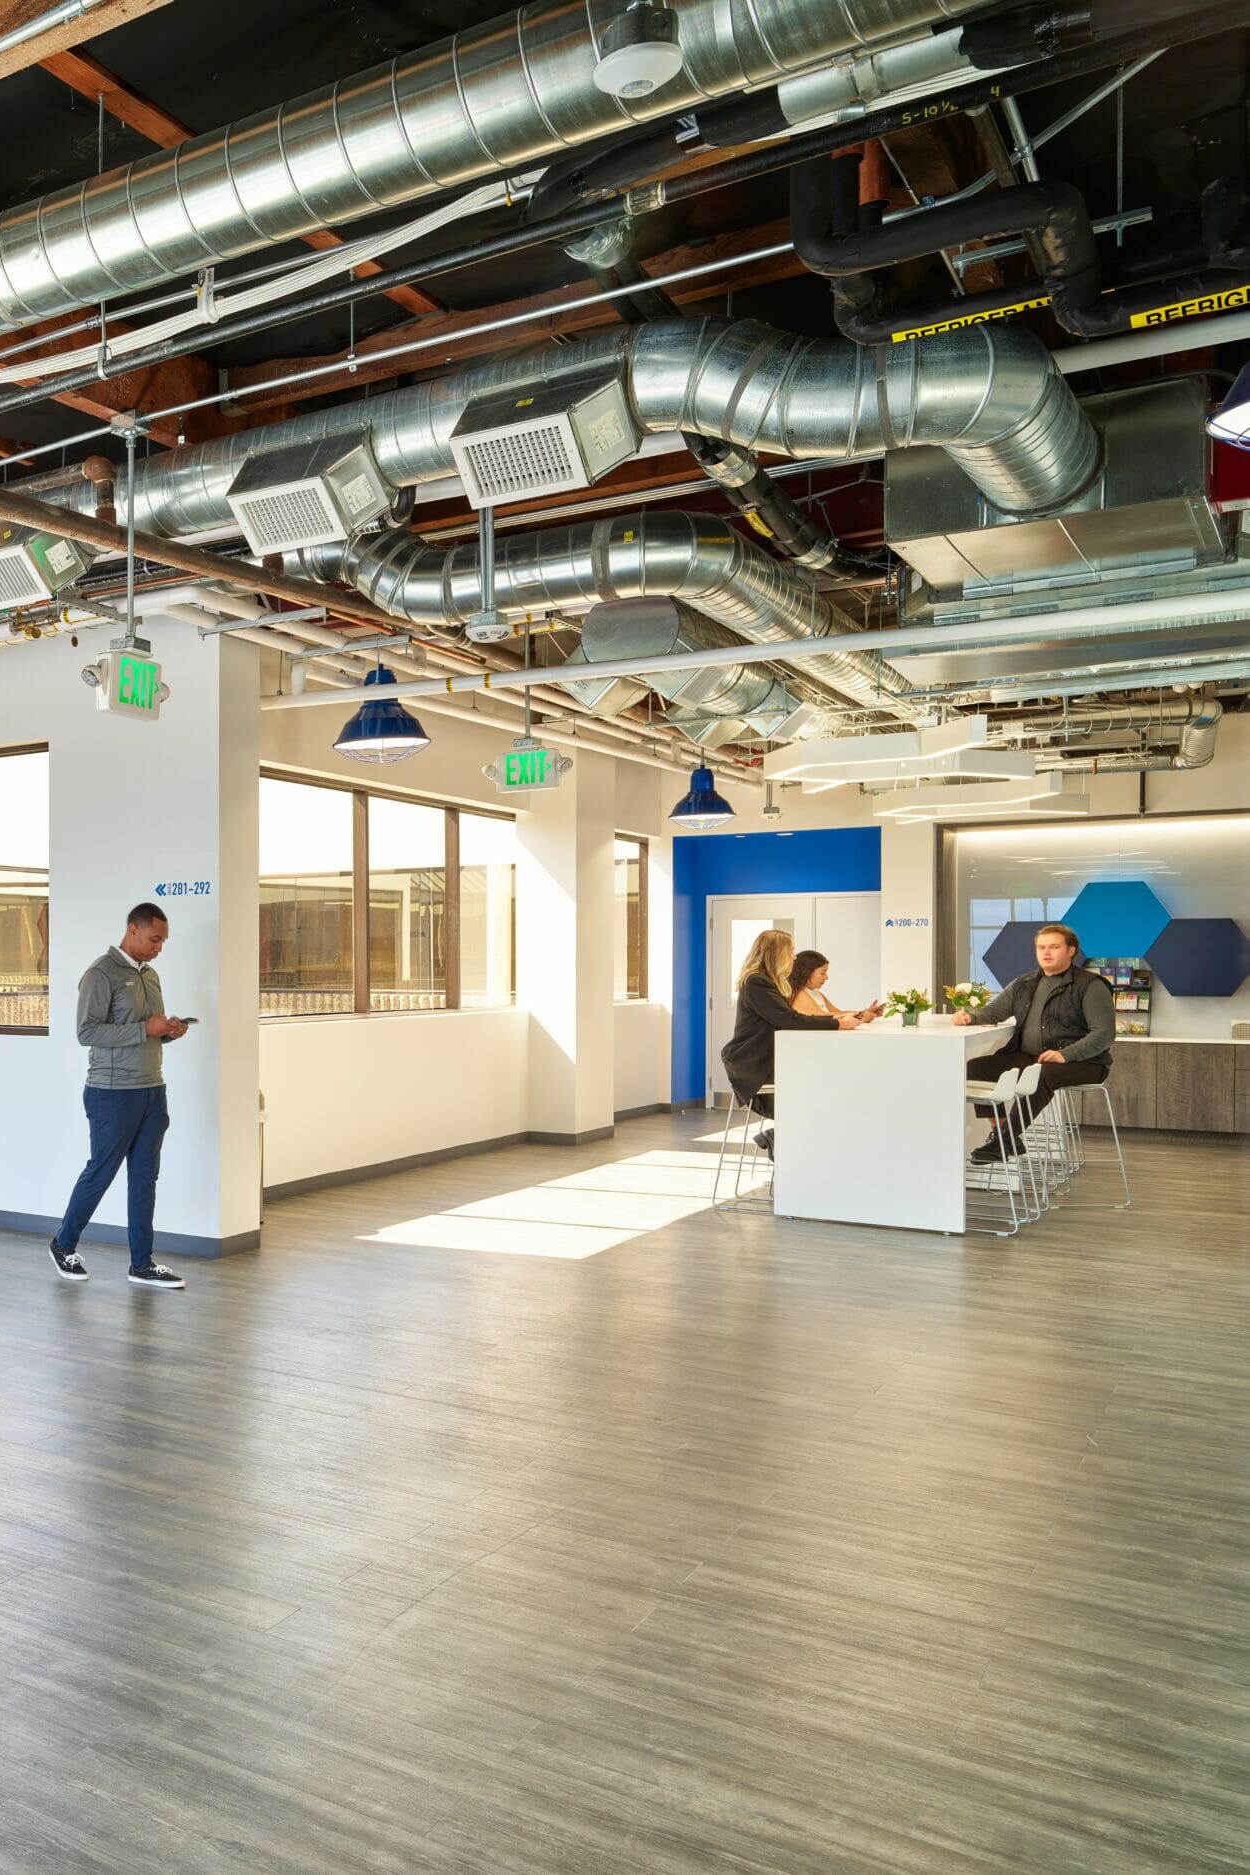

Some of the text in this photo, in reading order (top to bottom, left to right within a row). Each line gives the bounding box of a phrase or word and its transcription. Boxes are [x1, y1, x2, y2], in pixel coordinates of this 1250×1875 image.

[990, 85, 1000, 97] 4
[119, 656, 157, 710] EXIT
[505, 751, 548, 786] EXIT
[172, 881, 211, 896] 281-292
